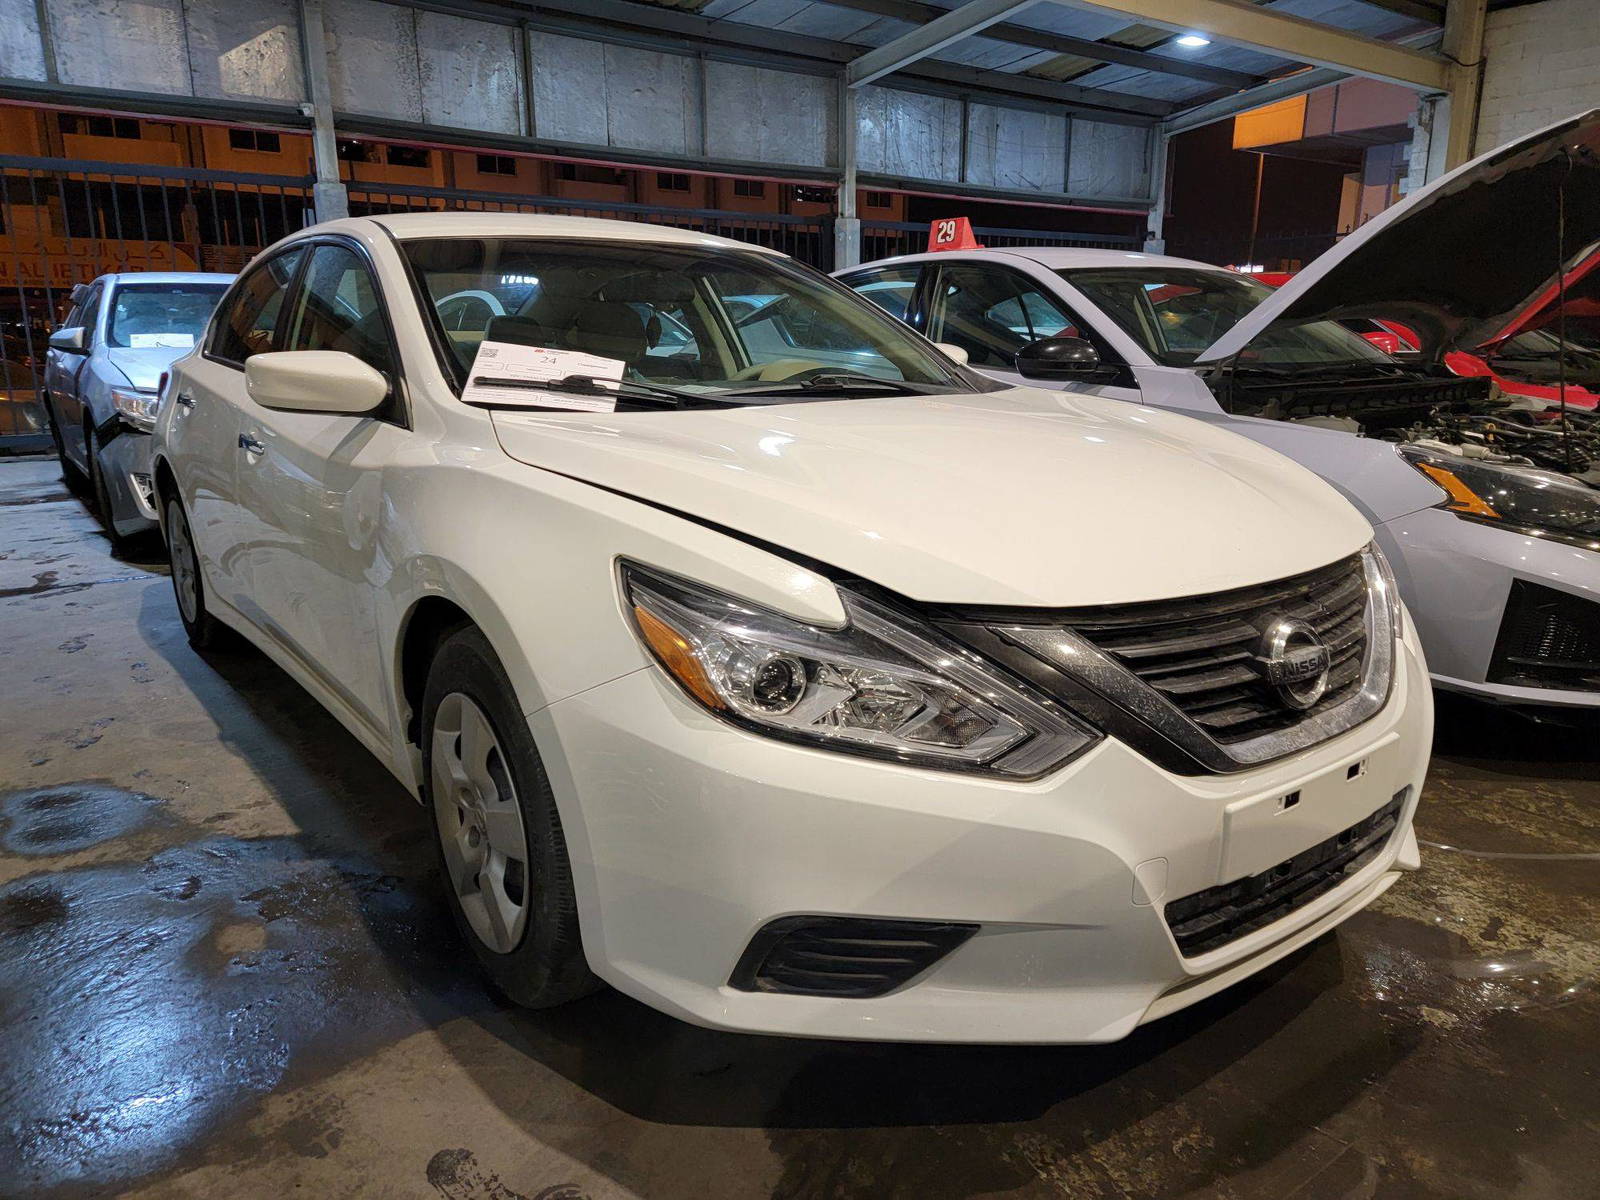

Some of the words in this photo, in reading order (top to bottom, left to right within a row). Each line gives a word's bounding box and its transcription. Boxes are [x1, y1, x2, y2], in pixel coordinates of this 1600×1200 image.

[937, 220, 956, 243] 29
[540, 355, 557, 364] 24
[1280, 654, 1329, 677] NISSAN
